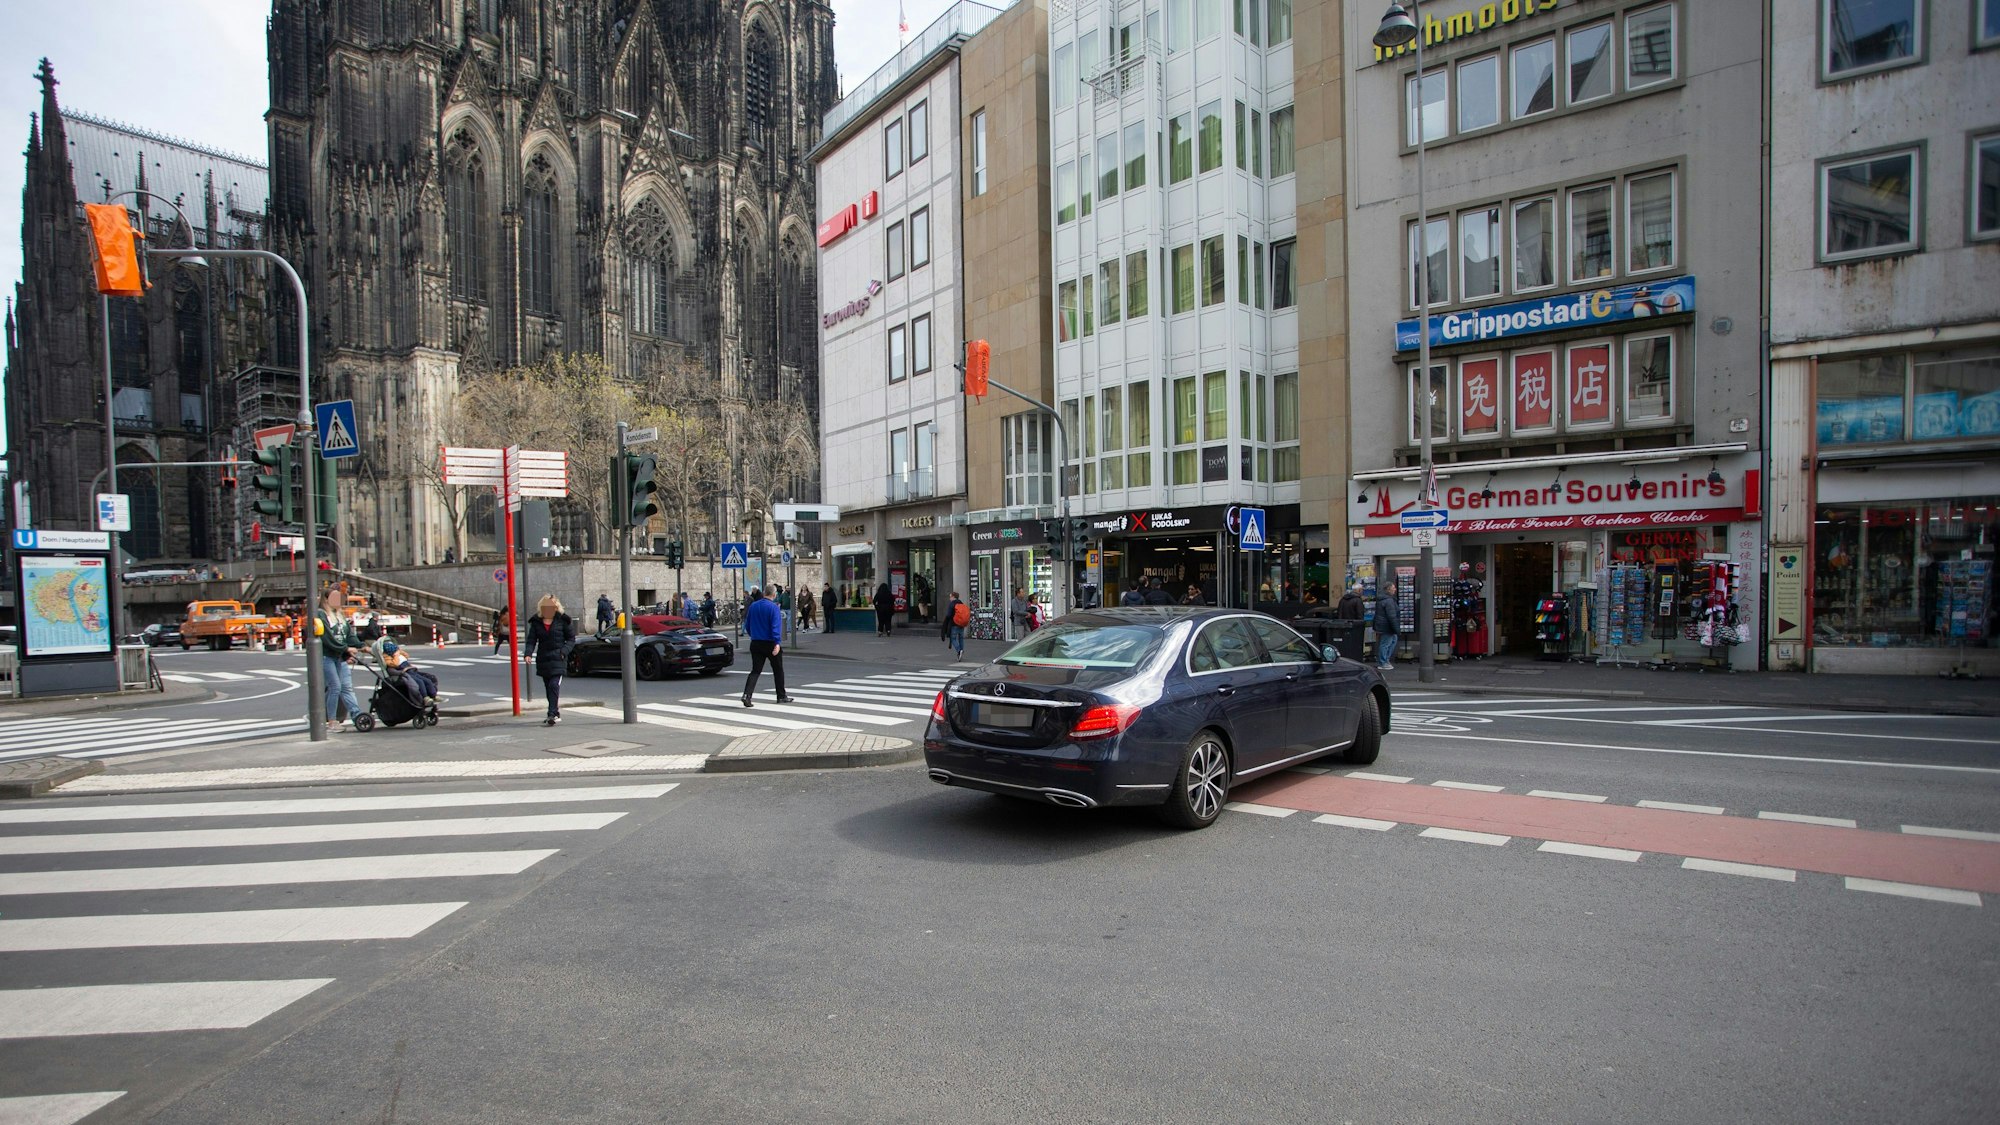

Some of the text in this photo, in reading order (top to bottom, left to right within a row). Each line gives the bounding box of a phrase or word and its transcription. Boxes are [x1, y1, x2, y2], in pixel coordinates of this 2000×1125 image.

[823, 296, 870, 329] Eurowings
[1442, 290, 1612, 340] Grippostad C
[1403, 338, 1420, 346] STAD
[1455, 360, 1607, 418] 免税店
[1447, 473, 1727, 511] German Souvenirs
[1780, 504, 1788, 512] 7
[902, 515, 935, 529] TICKETS
[1094, 516, 1123, 533] mangal
[1151, 512, 1173, 521] LUKAS
[1469, 518, 1520, 531] Black
[1521, 515, 1574, 529] Forest
[1581, 513, 1645, 527] Cuckoo
[1650, 510, 1710, 524] Clocks
[16, 531, 34, 547] U
[62, 536, 106, 544] Hauptbahnhof
[972, 531, 993, 541] Green
[1625, 529, 1709, 547] GERMAN
[1144, 563, 1179, 584] mangal
[1777, 571, 1800, 579] Point
